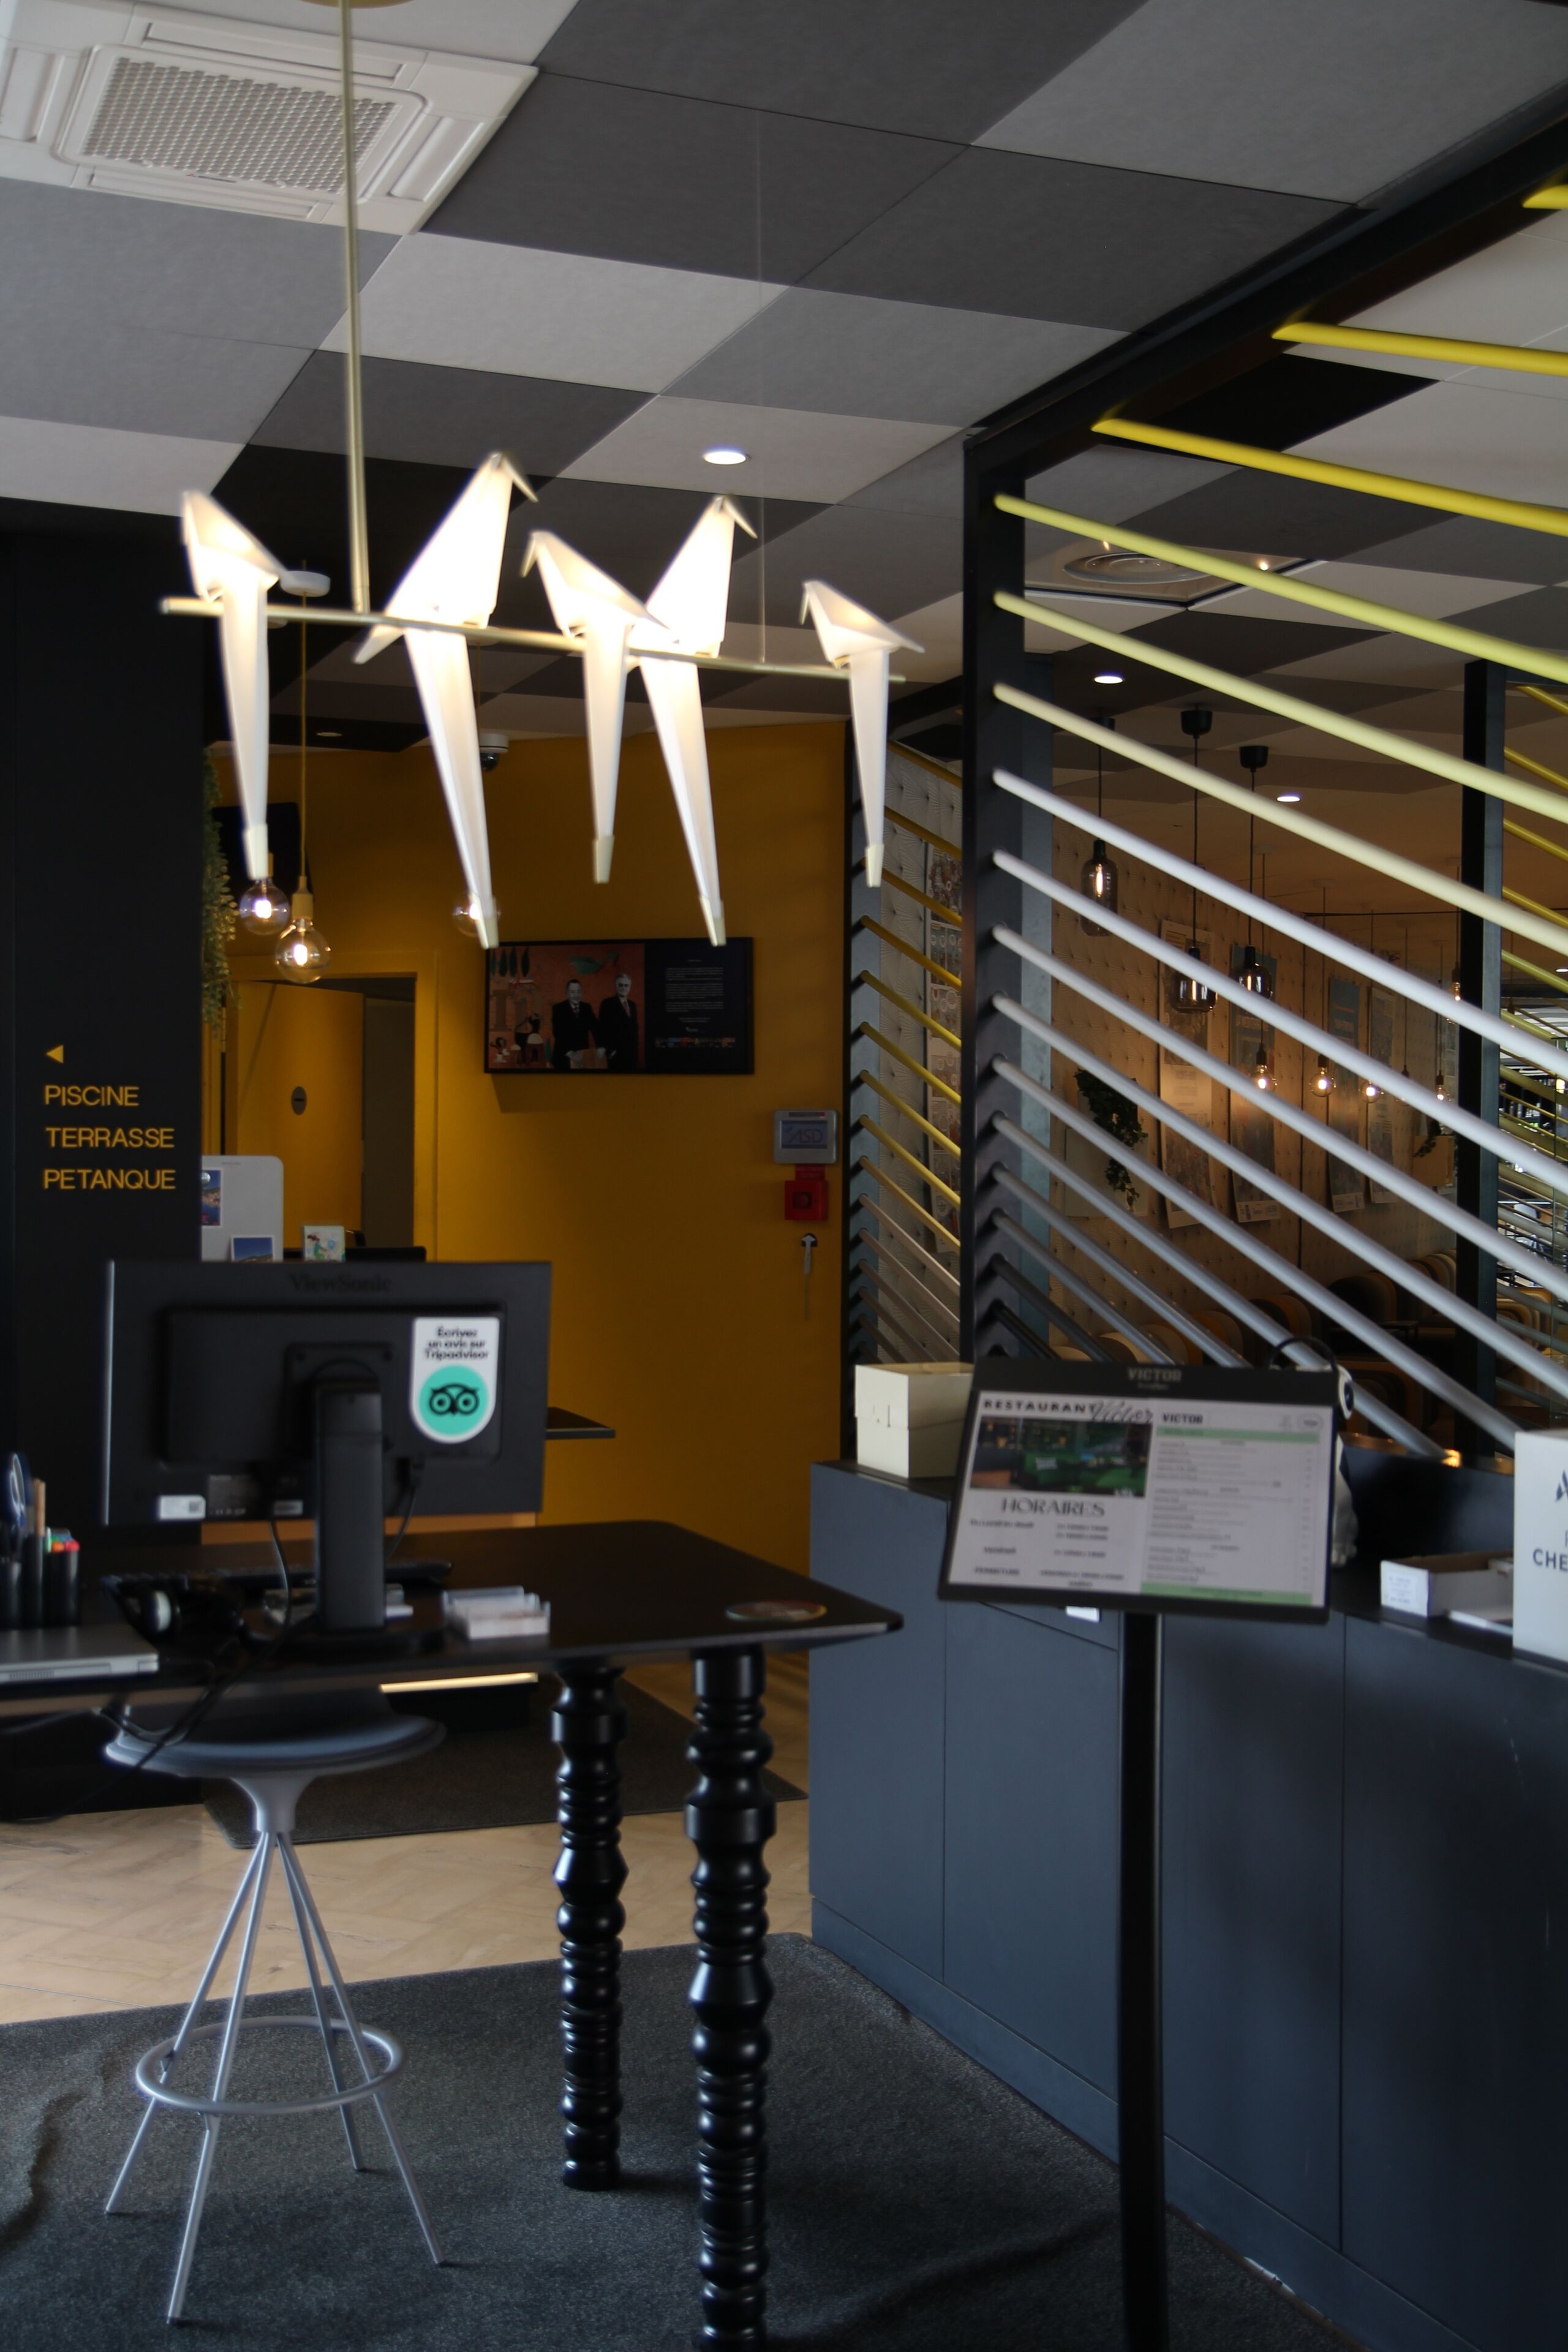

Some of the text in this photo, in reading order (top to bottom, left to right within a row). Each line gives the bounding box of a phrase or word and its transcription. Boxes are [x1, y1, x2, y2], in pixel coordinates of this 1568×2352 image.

[44, 1085, 139, 1106] PISCINE
[45, 1127, 175, 1148] TERRASSE
[43, 1169, 176, 1189] PETANQUE
[444, 1338, 467, 1348] avis
[470, 1340, 485, 1348] sur
[424, 1347, 489, 1360] Tripadvisor
[1127, 1368, 1182, 1382] VICTOR
[984, 1399, 1098, 1414] RESTAURANT
[1163, 1412, 1204, 1425] VICTOR
[1000, 1497, 1106, 1517] HORAIRES
